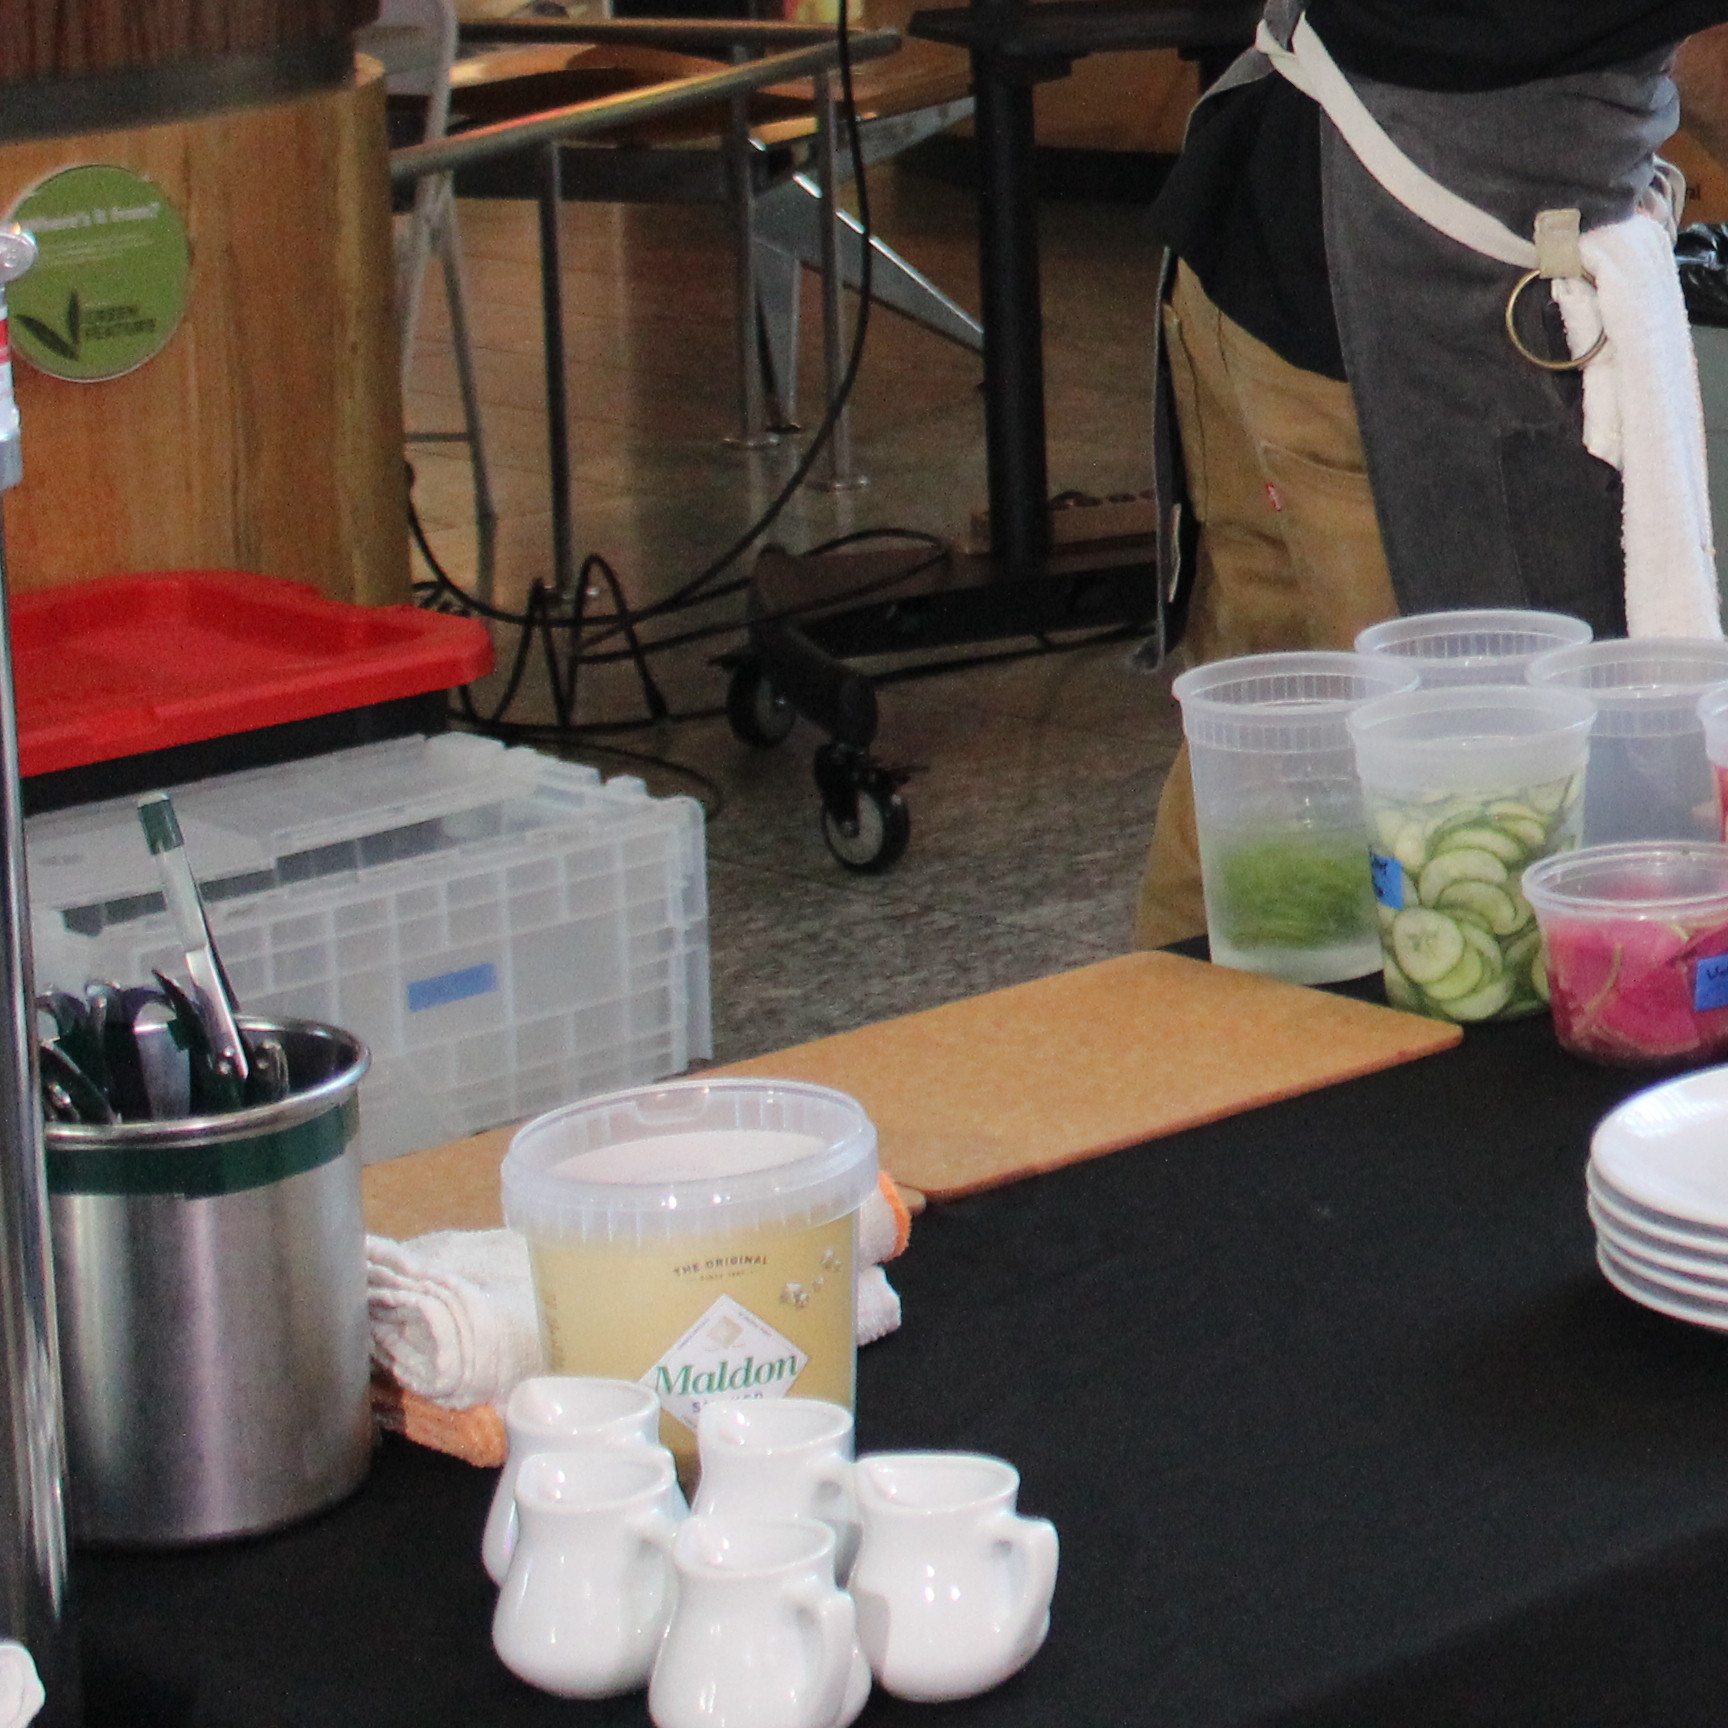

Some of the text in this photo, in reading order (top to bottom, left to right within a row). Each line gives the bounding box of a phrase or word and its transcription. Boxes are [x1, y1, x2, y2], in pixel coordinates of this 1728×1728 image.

[673, 1255, 769, 1277] THE ORIGINAL
[655, 1354, 799, 1397] Maldon
